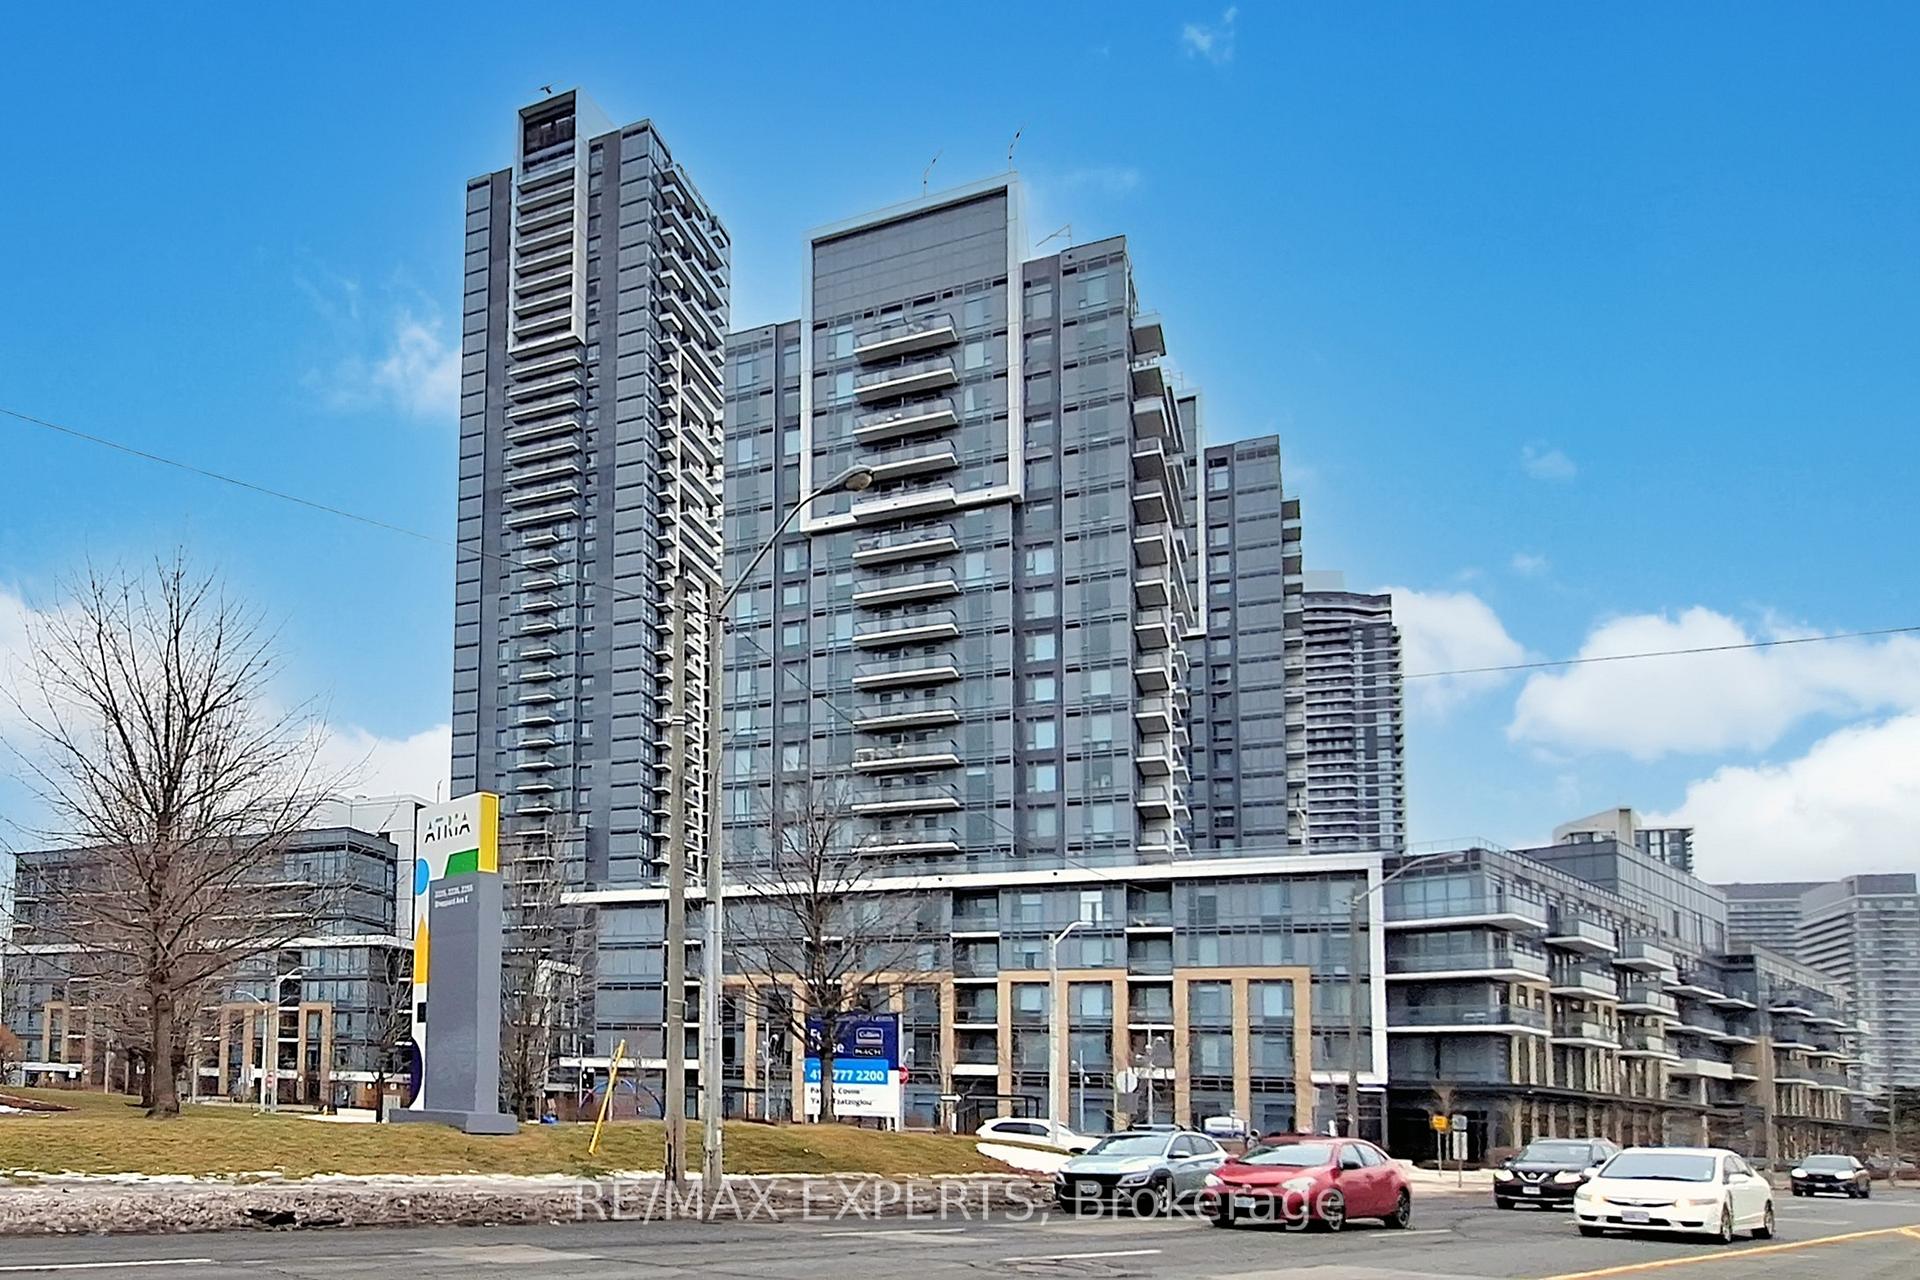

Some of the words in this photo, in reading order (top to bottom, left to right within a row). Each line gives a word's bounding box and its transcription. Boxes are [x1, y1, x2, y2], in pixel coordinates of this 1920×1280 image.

[425, 812, 470, 843] ATRIA
[833, 1070, 853, 1081] 777
[856, 1070, 885, 1082] 2200
